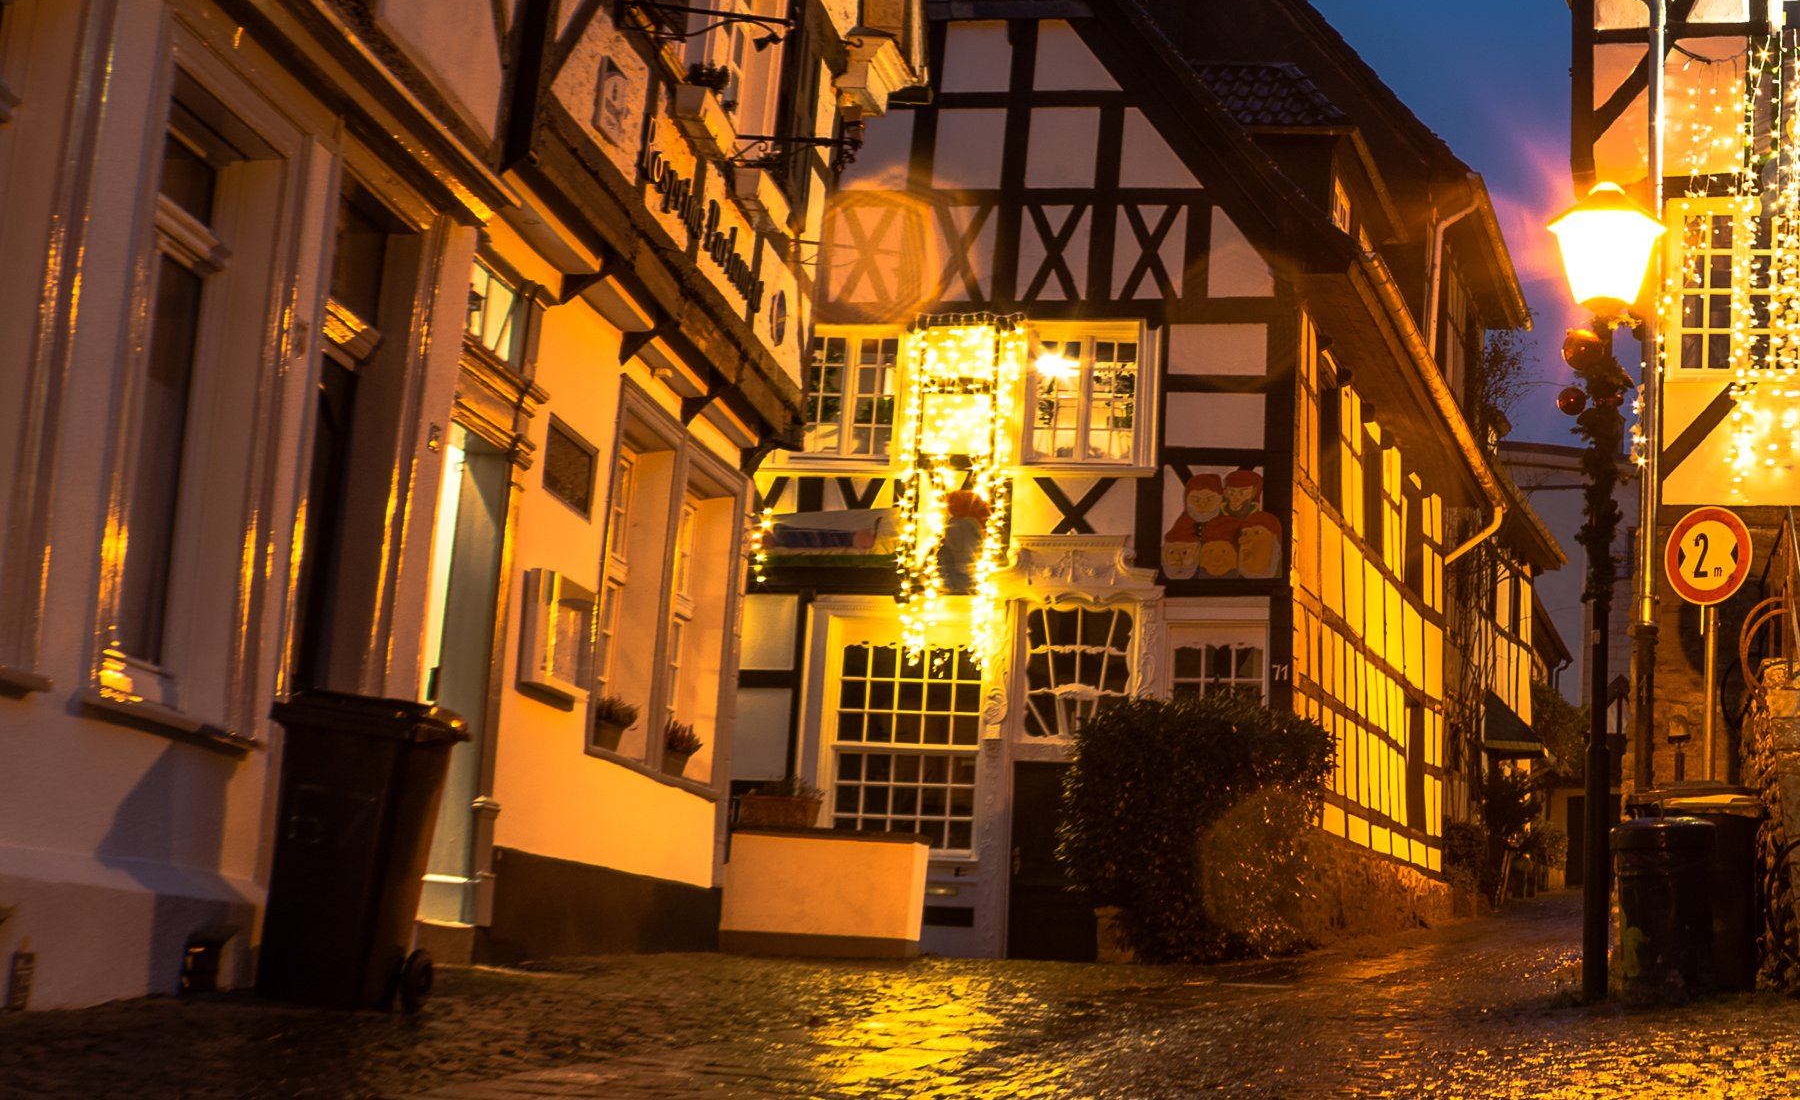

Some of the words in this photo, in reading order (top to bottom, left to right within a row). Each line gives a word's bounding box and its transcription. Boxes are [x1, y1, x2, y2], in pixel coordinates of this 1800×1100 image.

[1693, 532, 1709, 578] 2
[1713, 566, 1722, 578] m
[1271, 664, 1289, 681] 71
